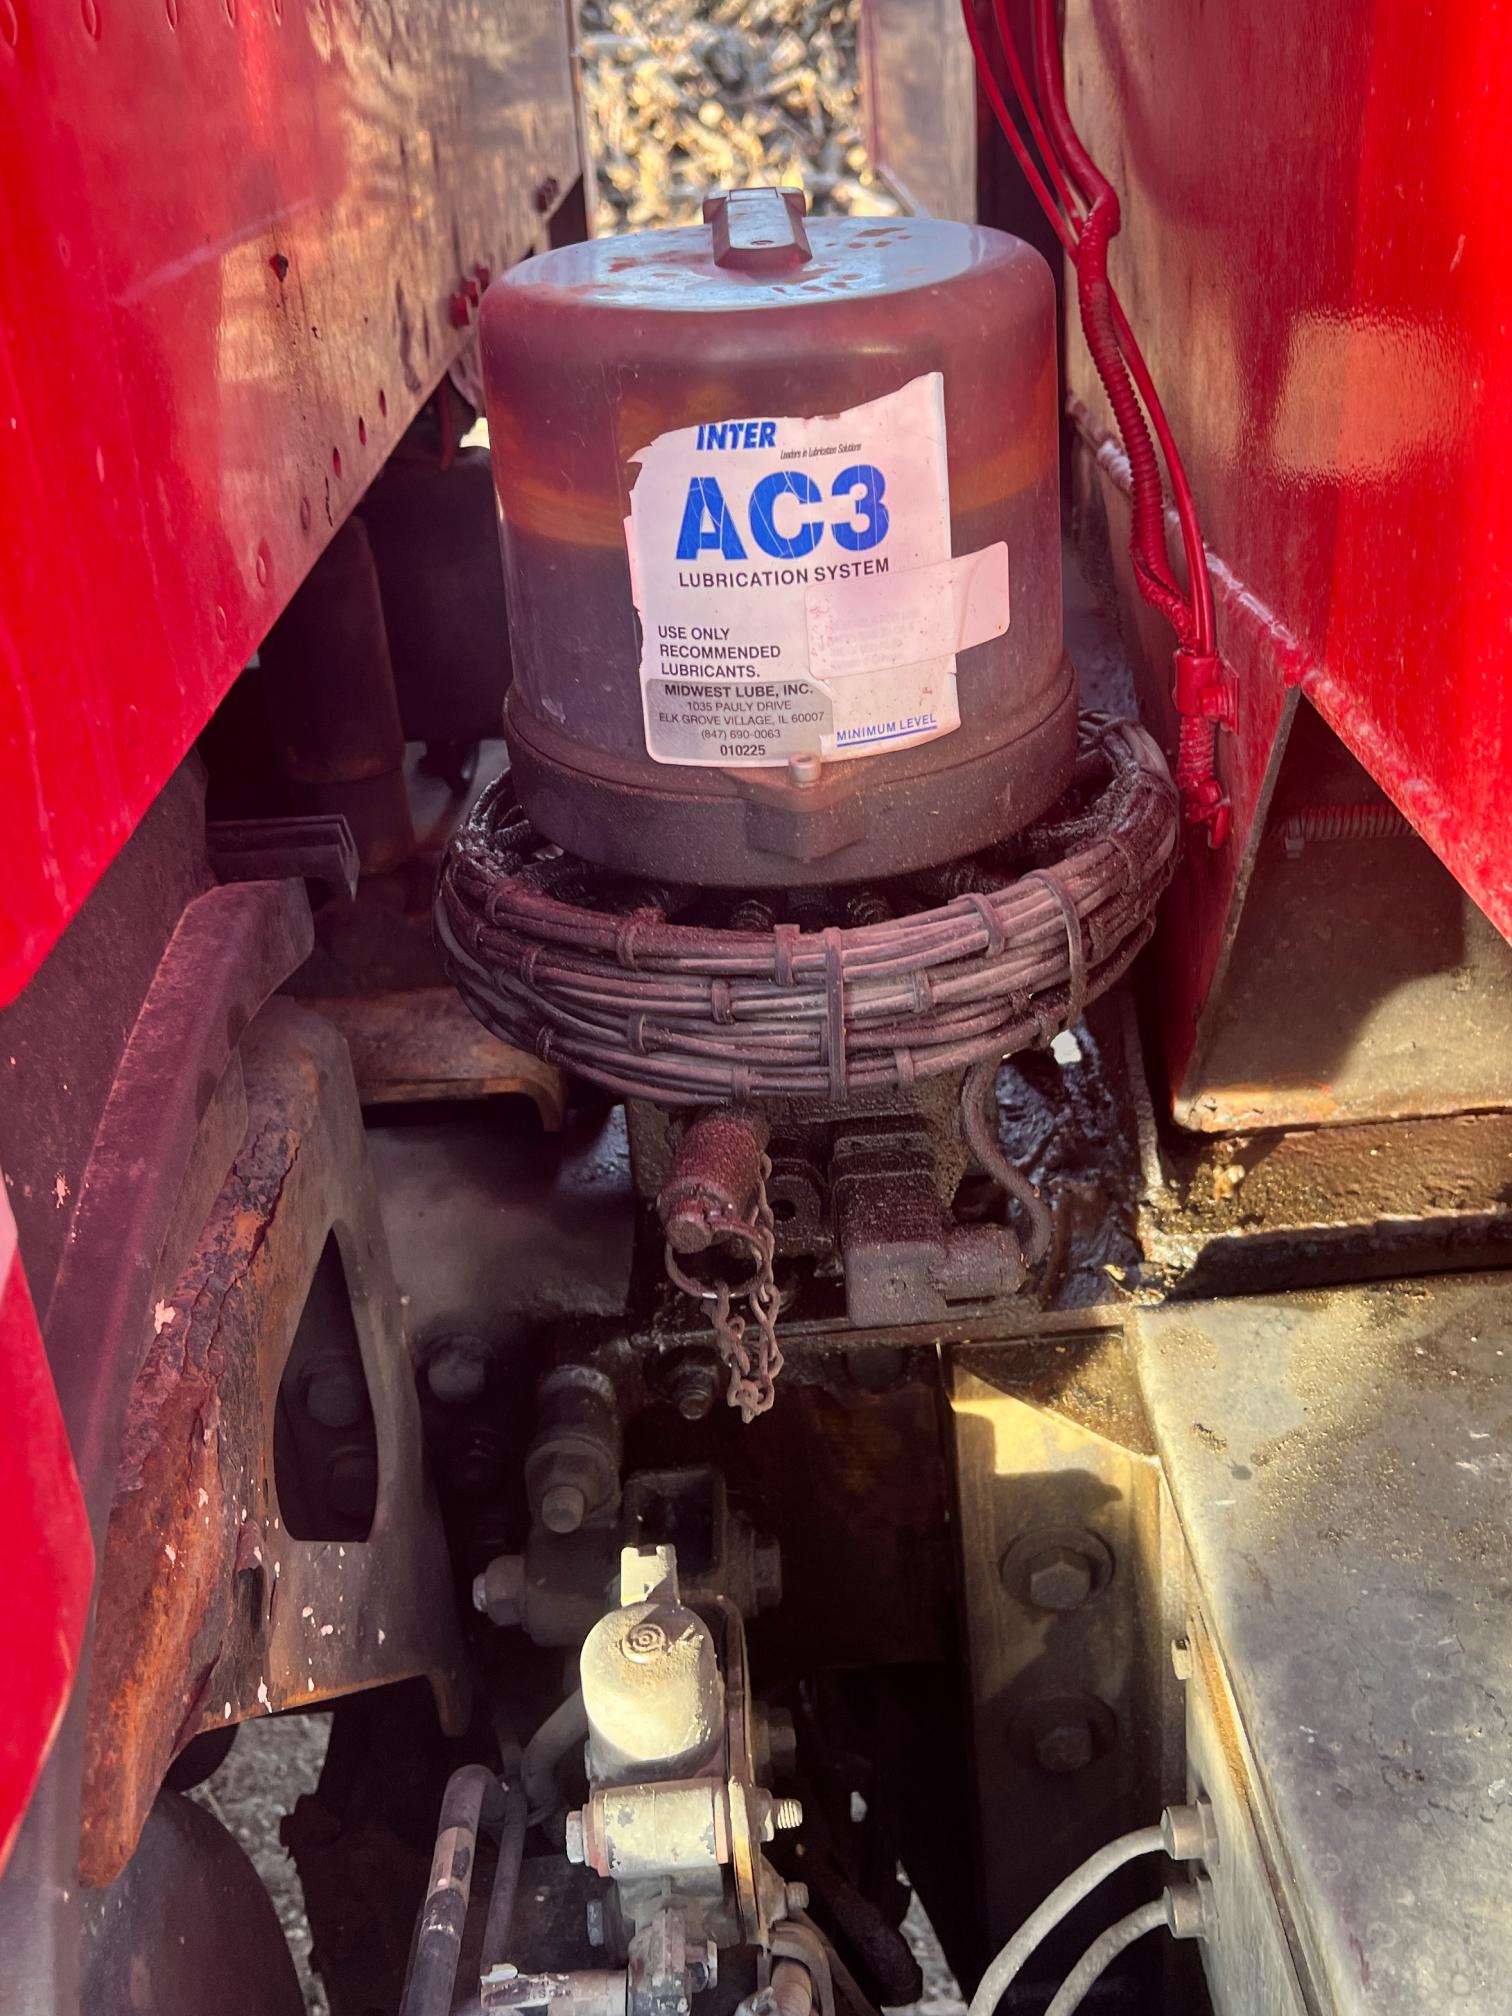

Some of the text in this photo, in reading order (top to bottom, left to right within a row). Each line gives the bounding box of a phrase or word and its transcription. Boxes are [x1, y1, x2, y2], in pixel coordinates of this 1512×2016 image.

[696, 422, 776, 450] INTER
[780, 449, 801, 460] Leaders
[808, 446, 837, 458] Lubrication
[838, 443, 862, 454] Solutions
[675, 464, 889, 560] AC3
[679, 557, 889, 588] LUBRICATION SYSTEM
[658, 625, 730, 641] USE ONLY
[660, 644, 781, 660] RECOMMENDED
[661, 662, 760, 678] LUBRICANTS.
[664, 683, 813, 699] MIDWEST LUBE, INC.
[687, 700, 792, 712] 1035 PAULY DRIVE
[659, 711, 824, 726] ELK GROVE VILLAGE, IL 60007
[701, 729, 781, 741] (847) 690-0063
[836, 713, 937, 741] MINIMUM LEVEL
[720, 744, 766, 757] 010225
